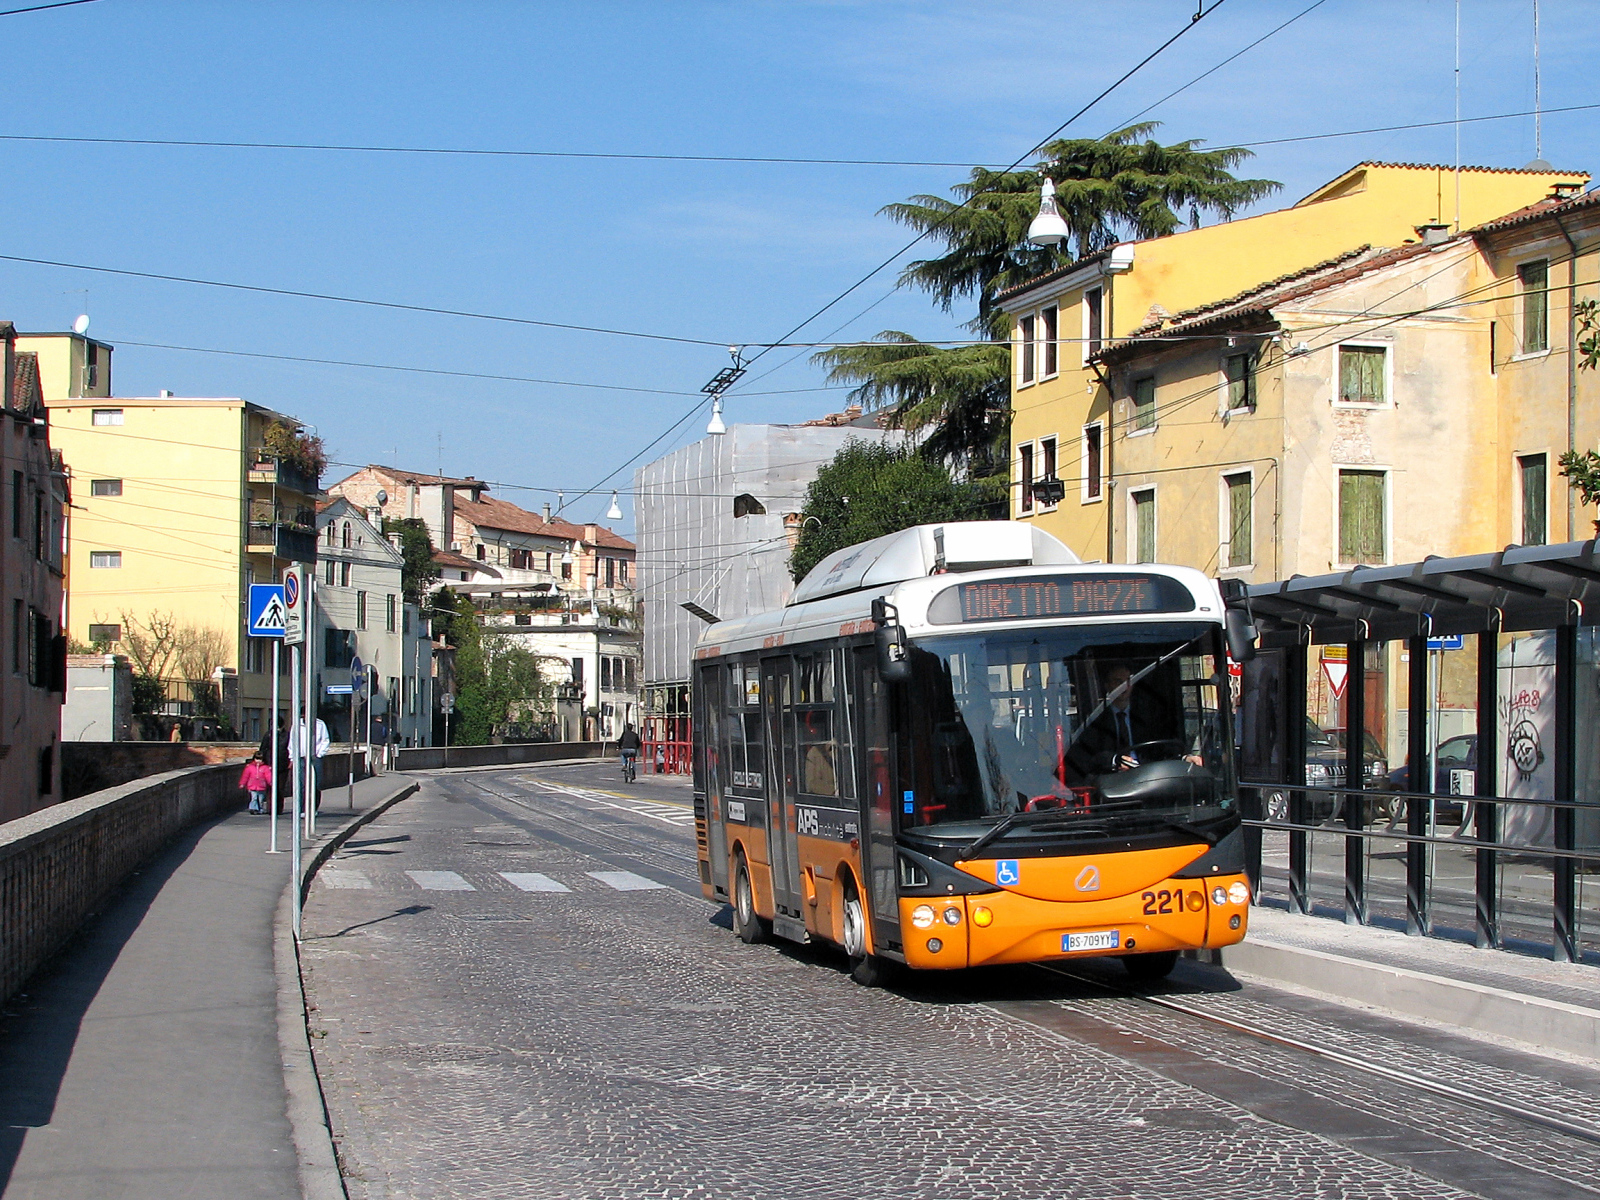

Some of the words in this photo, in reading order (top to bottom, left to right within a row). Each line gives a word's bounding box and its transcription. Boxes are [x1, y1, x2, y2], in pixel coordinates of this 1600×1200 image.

[965, 581, 1060, 619] DIRETTO
[797, 808, 819, 836] APS
[1141, 889, 1184, 916] 221
